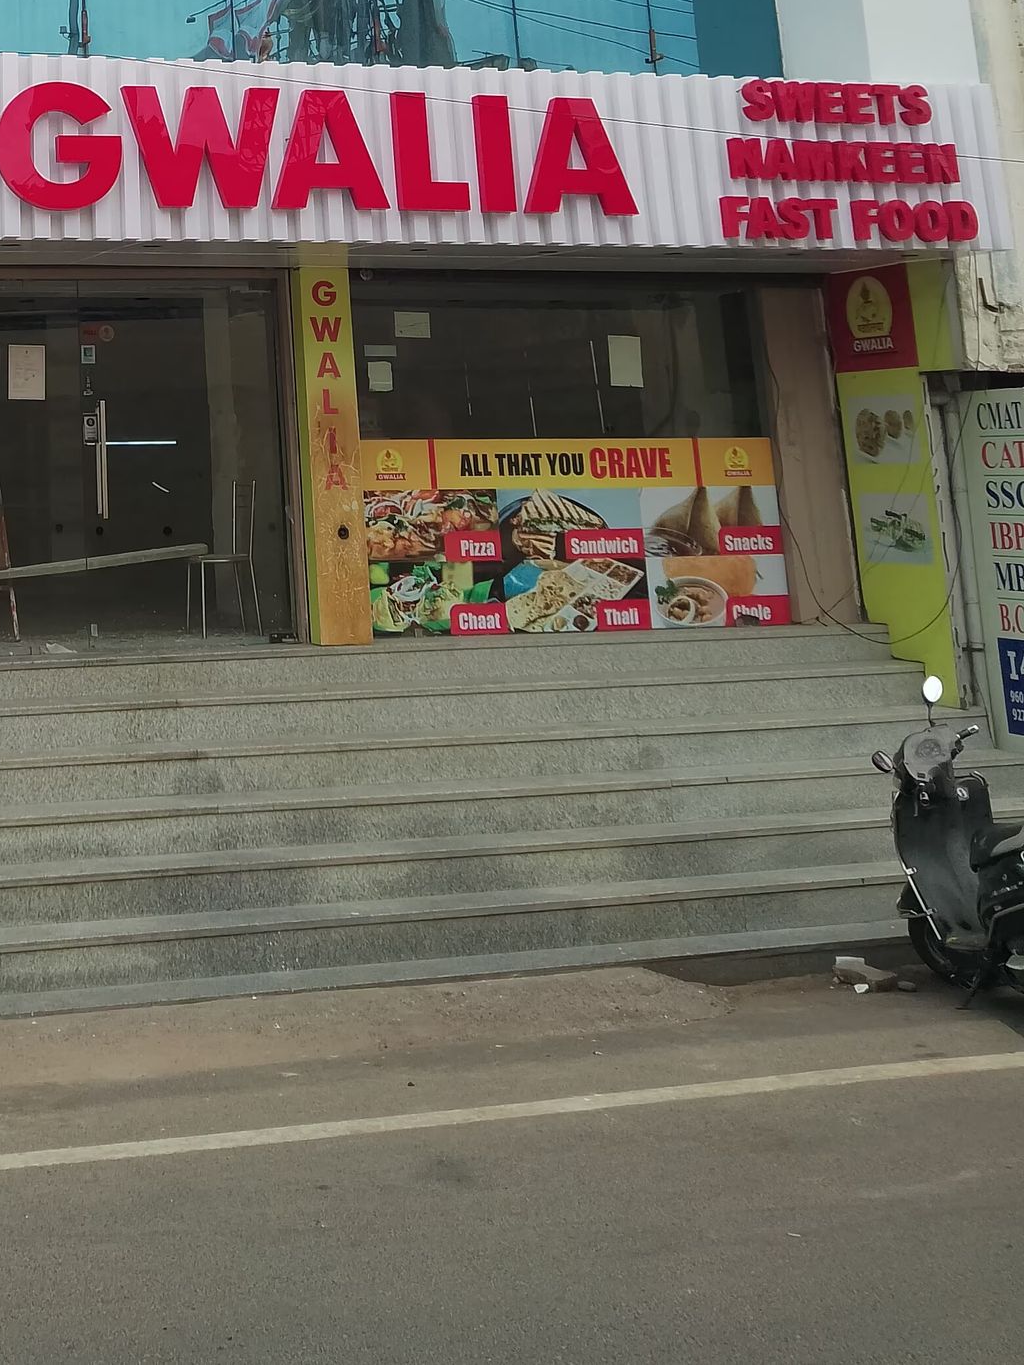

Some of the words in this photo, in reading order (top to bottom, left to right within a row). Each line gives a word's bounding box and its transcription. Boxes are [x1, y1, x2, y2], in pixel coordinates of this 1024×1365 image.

[741, 79, 933, 126] SWEETS
[726, 137, 961, 184] NAMKEEN
[719, 196, 838, 240] FAST
[850, 199, 979, 242] FOOD
[853, 337, 893, 352] GWALIA
[309, 280, 348, 491] GWALIA
[977, 402, 1022, 430] CMAT
[460, 453, 492, 476] ALL
[494, 453, 542, 476] THAT
[545, 452, 585, 476] YOU
[589, 447, 673, 479] CRAVE
[460, 539, 496, 556] Pizza
[570, 536, 639, 555] Sandwich
[724, 534, 774, 552] Snacks
[458, 611, 502, 630] Chaat
[603, 607, 640, 626] Thali
